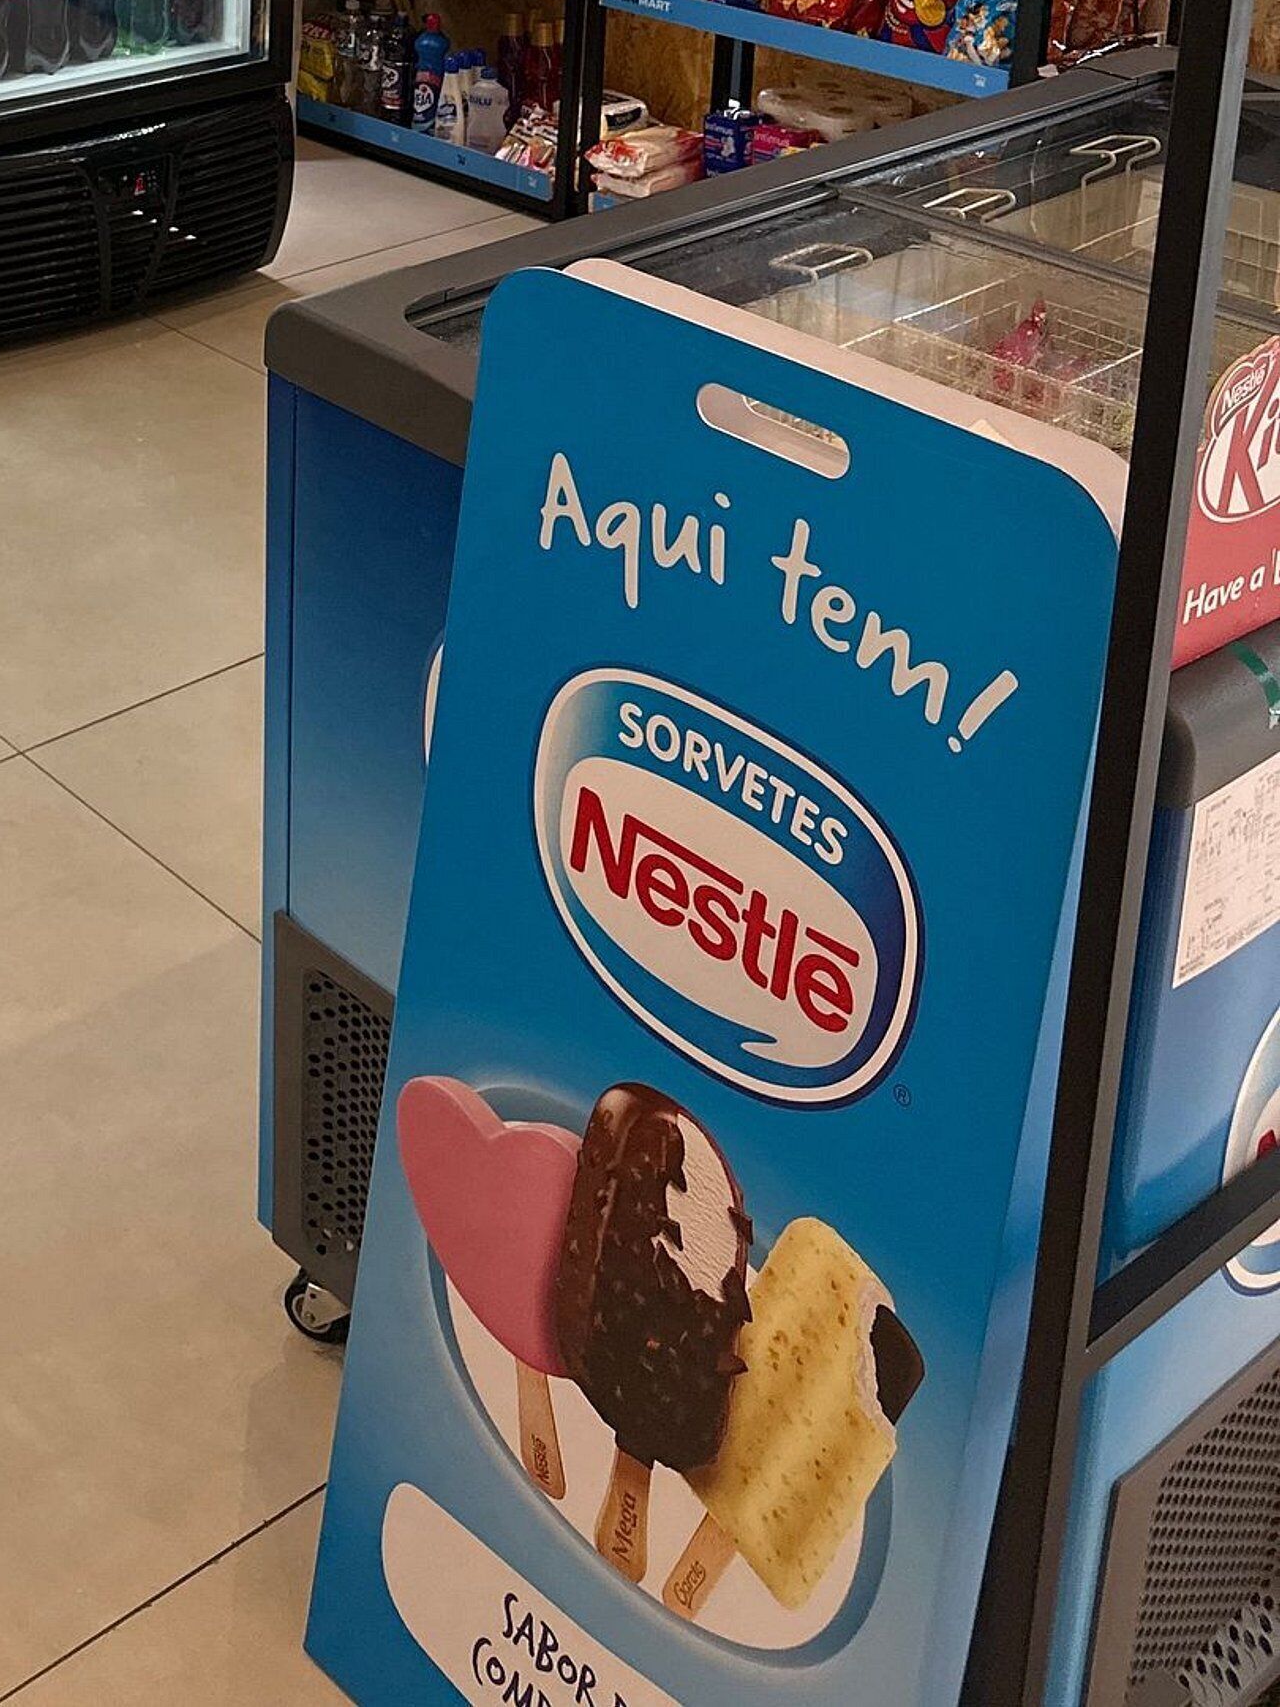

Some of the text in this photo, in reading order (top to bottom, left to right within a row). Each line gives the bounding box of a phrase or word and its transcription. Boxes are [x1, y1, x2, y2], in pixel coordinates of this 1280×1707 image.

[539, 451, 1020, 754] Aqui tem!
[1182, 565, 1266, 626] Have a
[617, 702, 848, 865] SORVETES
[568, 785, 861, 1034] Nestlé
[612, 1492, 638, 1565] Mega
[502, 1592, 597, 1707] SABOR
